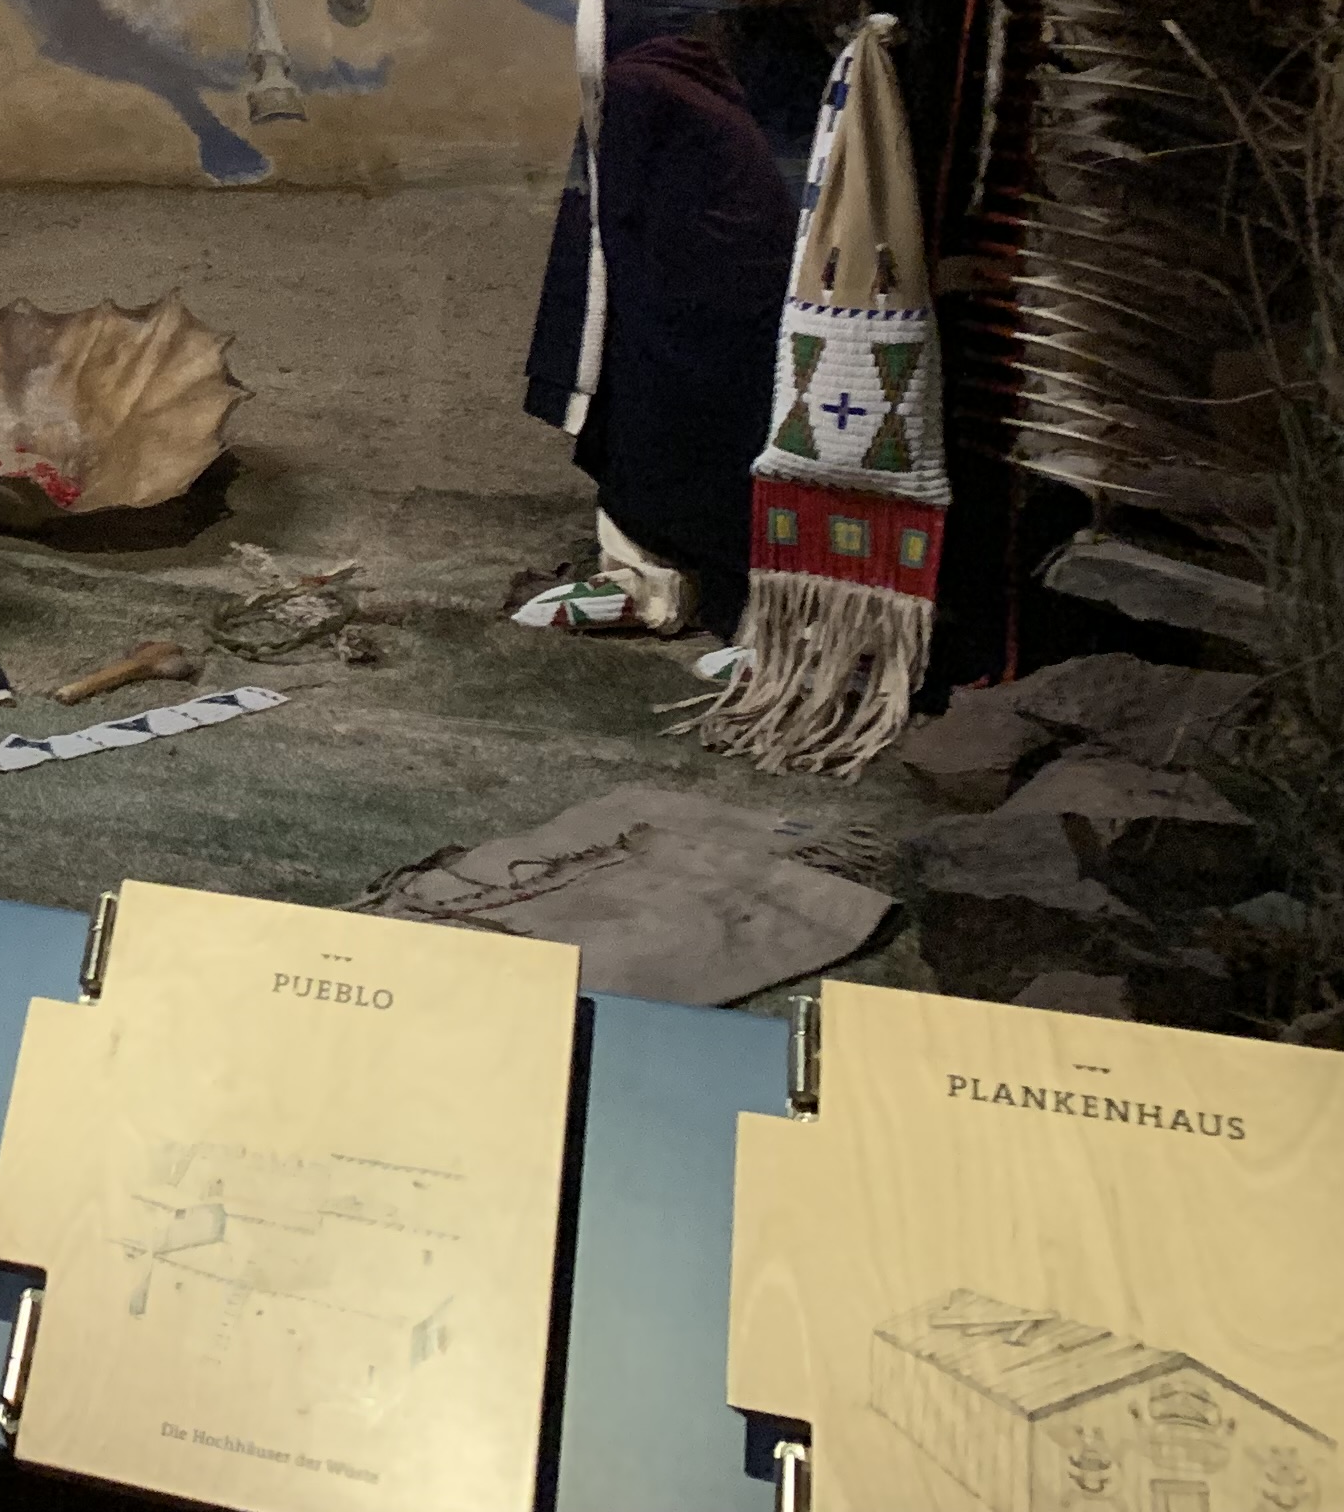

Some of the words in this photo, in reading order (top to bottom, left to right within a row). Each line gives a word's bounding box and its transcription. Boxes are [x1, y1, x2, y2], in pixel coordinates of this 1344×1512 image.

[272, 972, 394, 1010] PUEBLO
[946, 1074, 1246, 1140] PLANKENHAUS
[161, 1421, 187, 1441] Die
[192, 1428, 291, 1464] Hochhäuser
